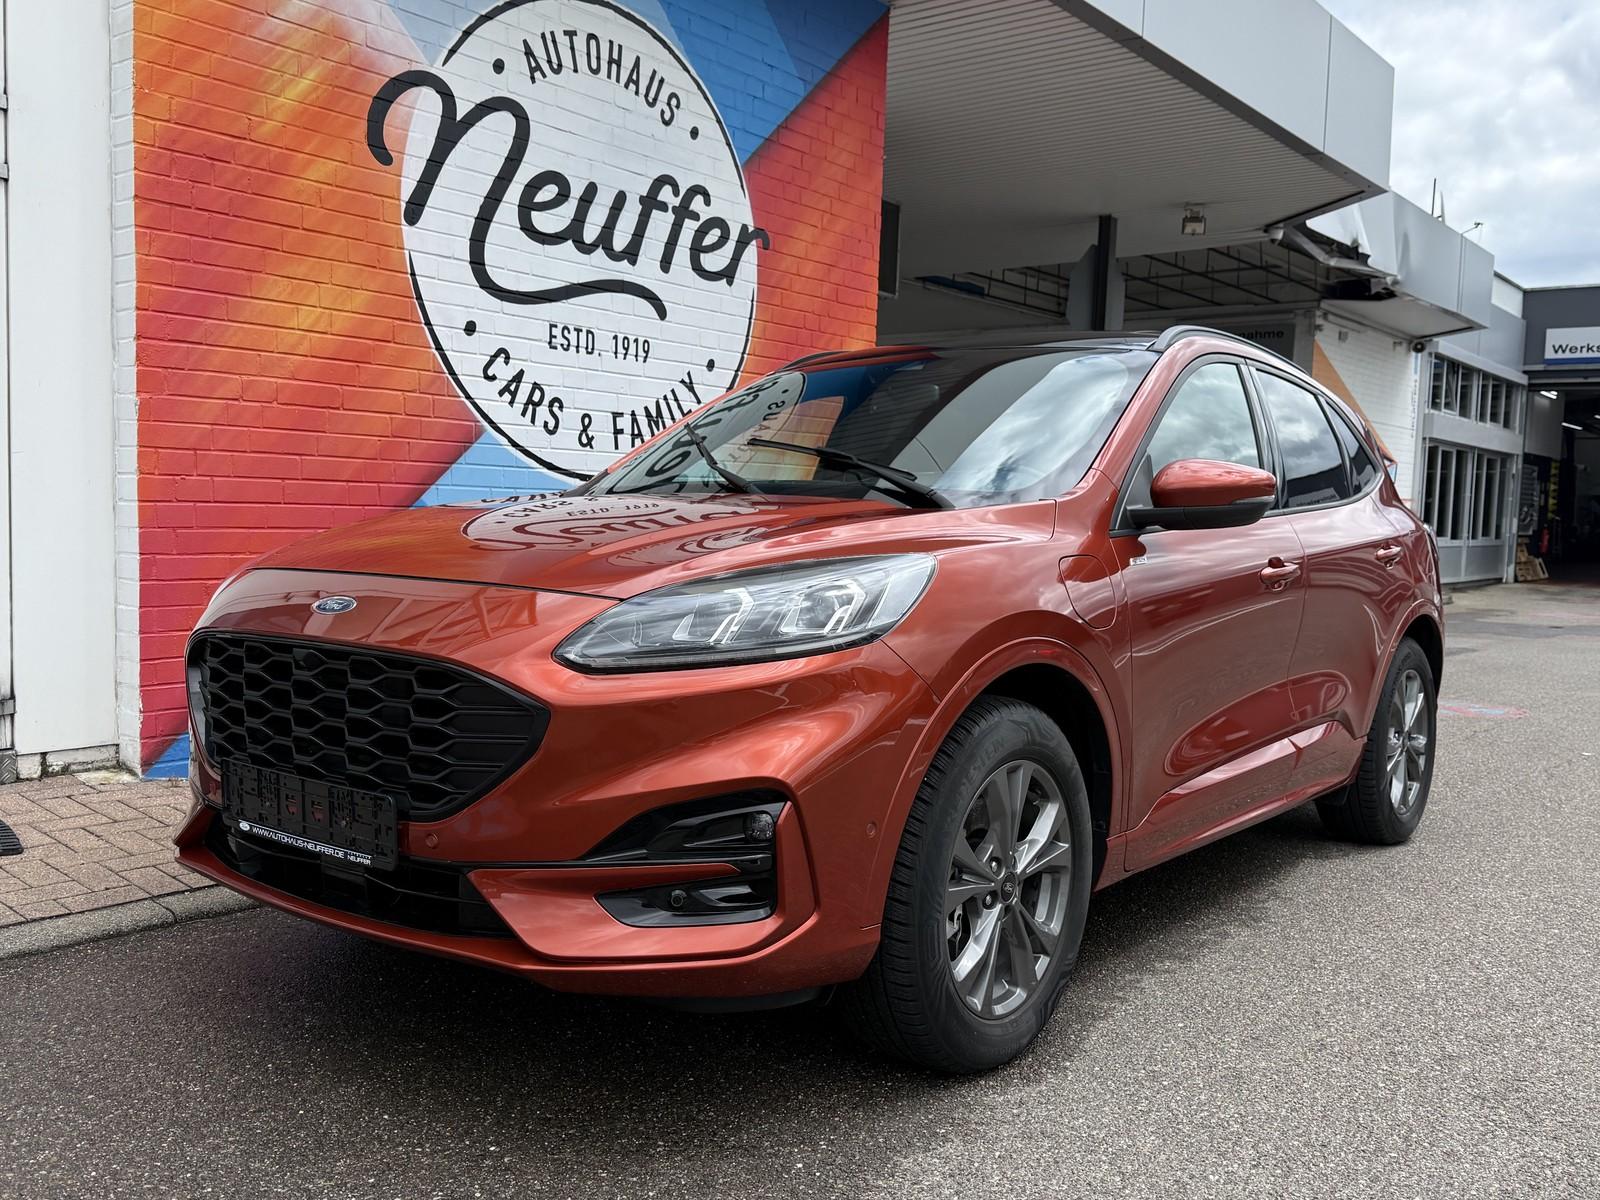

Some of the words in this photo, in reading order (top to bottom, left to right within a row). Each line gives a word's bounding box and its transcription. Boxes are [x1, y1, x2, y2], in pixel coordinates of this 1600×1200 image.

[522, 29, 682, 129] AUTOHAUS
[366, 69, 770, 320] Neuffer
[548, 322, 602, 358] ESTD.
[611, 334, 651, 364] 1919
[482, 347, 564, 436] CARS
[577, 412, 595, 449] &
[612, 370, 705, 450] FAMILY
[252, 827, 345, 859] WWW.AUTOHAUS-NEUFFER.DE
[347, 854, 372, 866] NEUFFER
